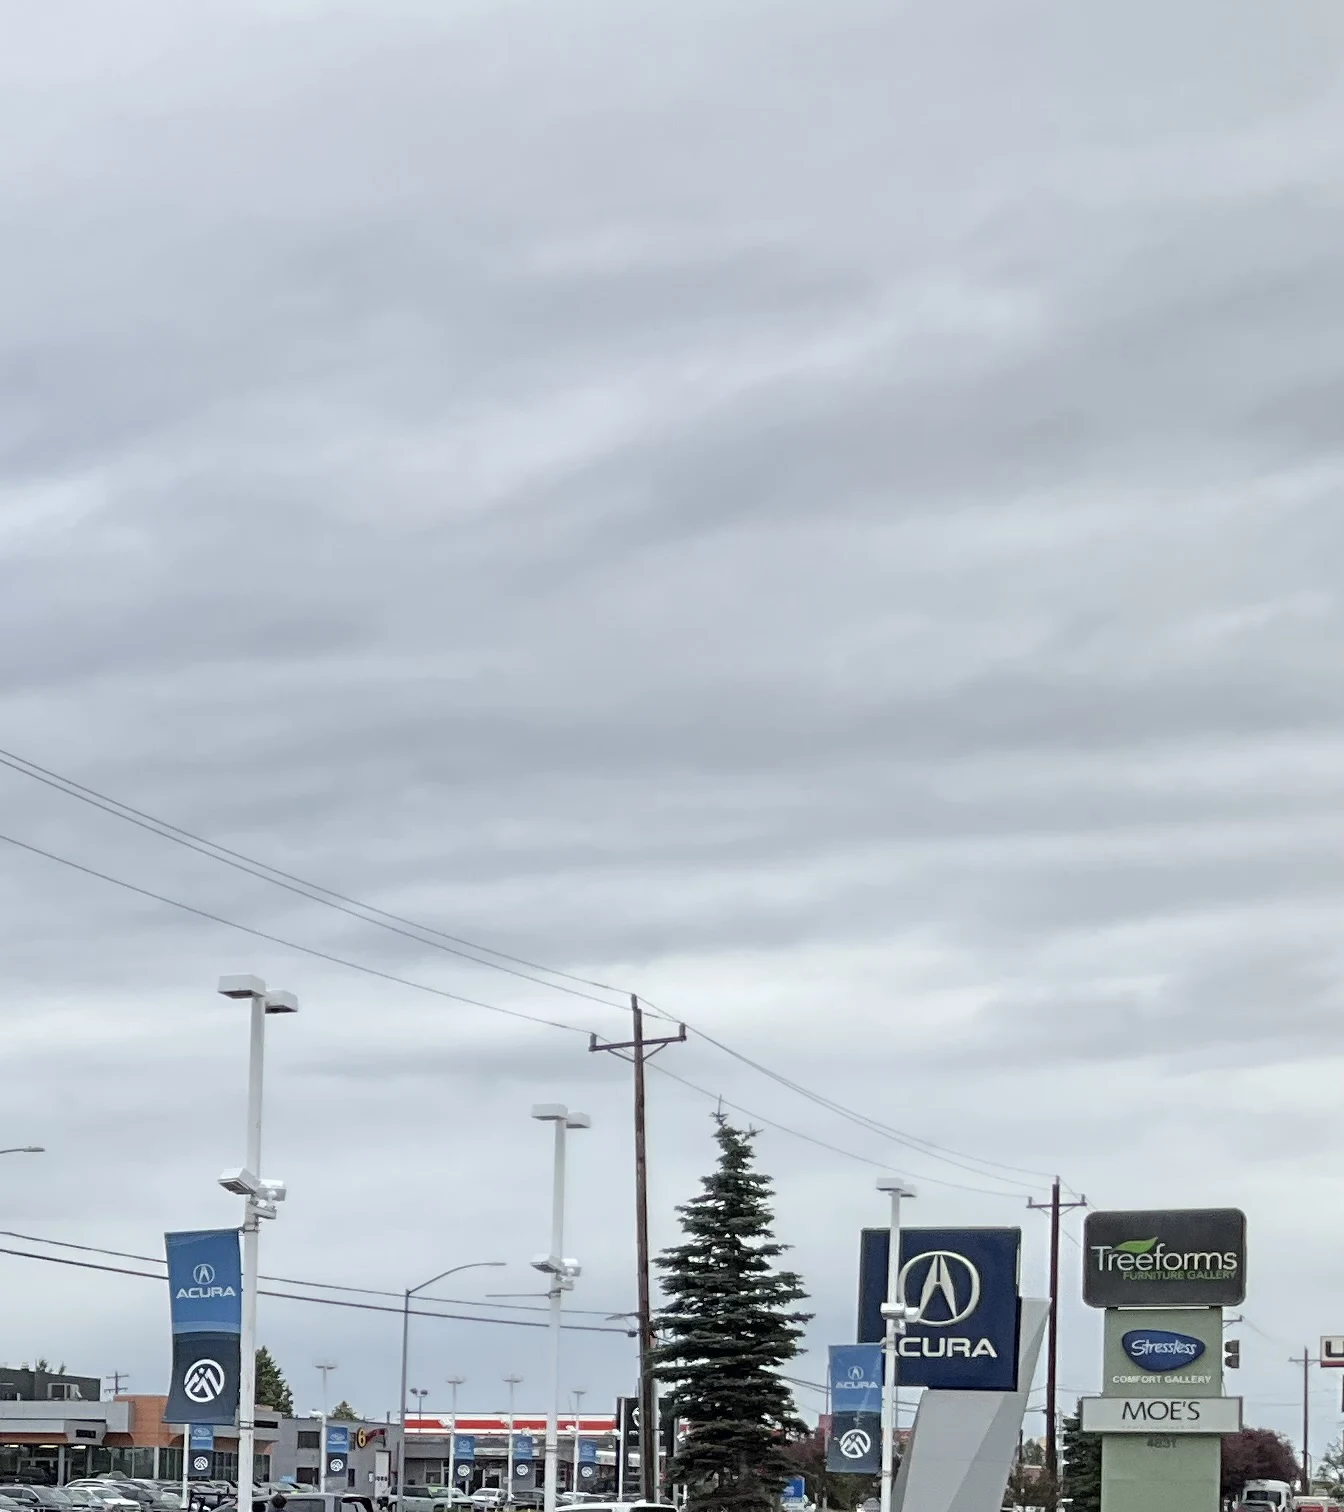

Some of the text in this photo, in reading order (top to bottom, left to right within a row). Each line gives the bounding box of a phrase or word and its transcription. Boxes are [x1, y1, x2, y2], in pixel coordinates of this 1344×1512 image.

[1090, 1243, 1238, 1272] Treeforms
[1123, 1270, 1237, 1281] FURNITURE GALLERY
[176, 1285, 236, 1299] ACURA
[882, 1337, 998, 1358] CURA
[1130, 1339, 1197, 1357] Stressless
[835, 1381, 879, 1389] ACURA
[1112, 1375, 1212, 1384] COMFORT GALLERY
[1122, 1401, 1200, 1421] MOE'S
